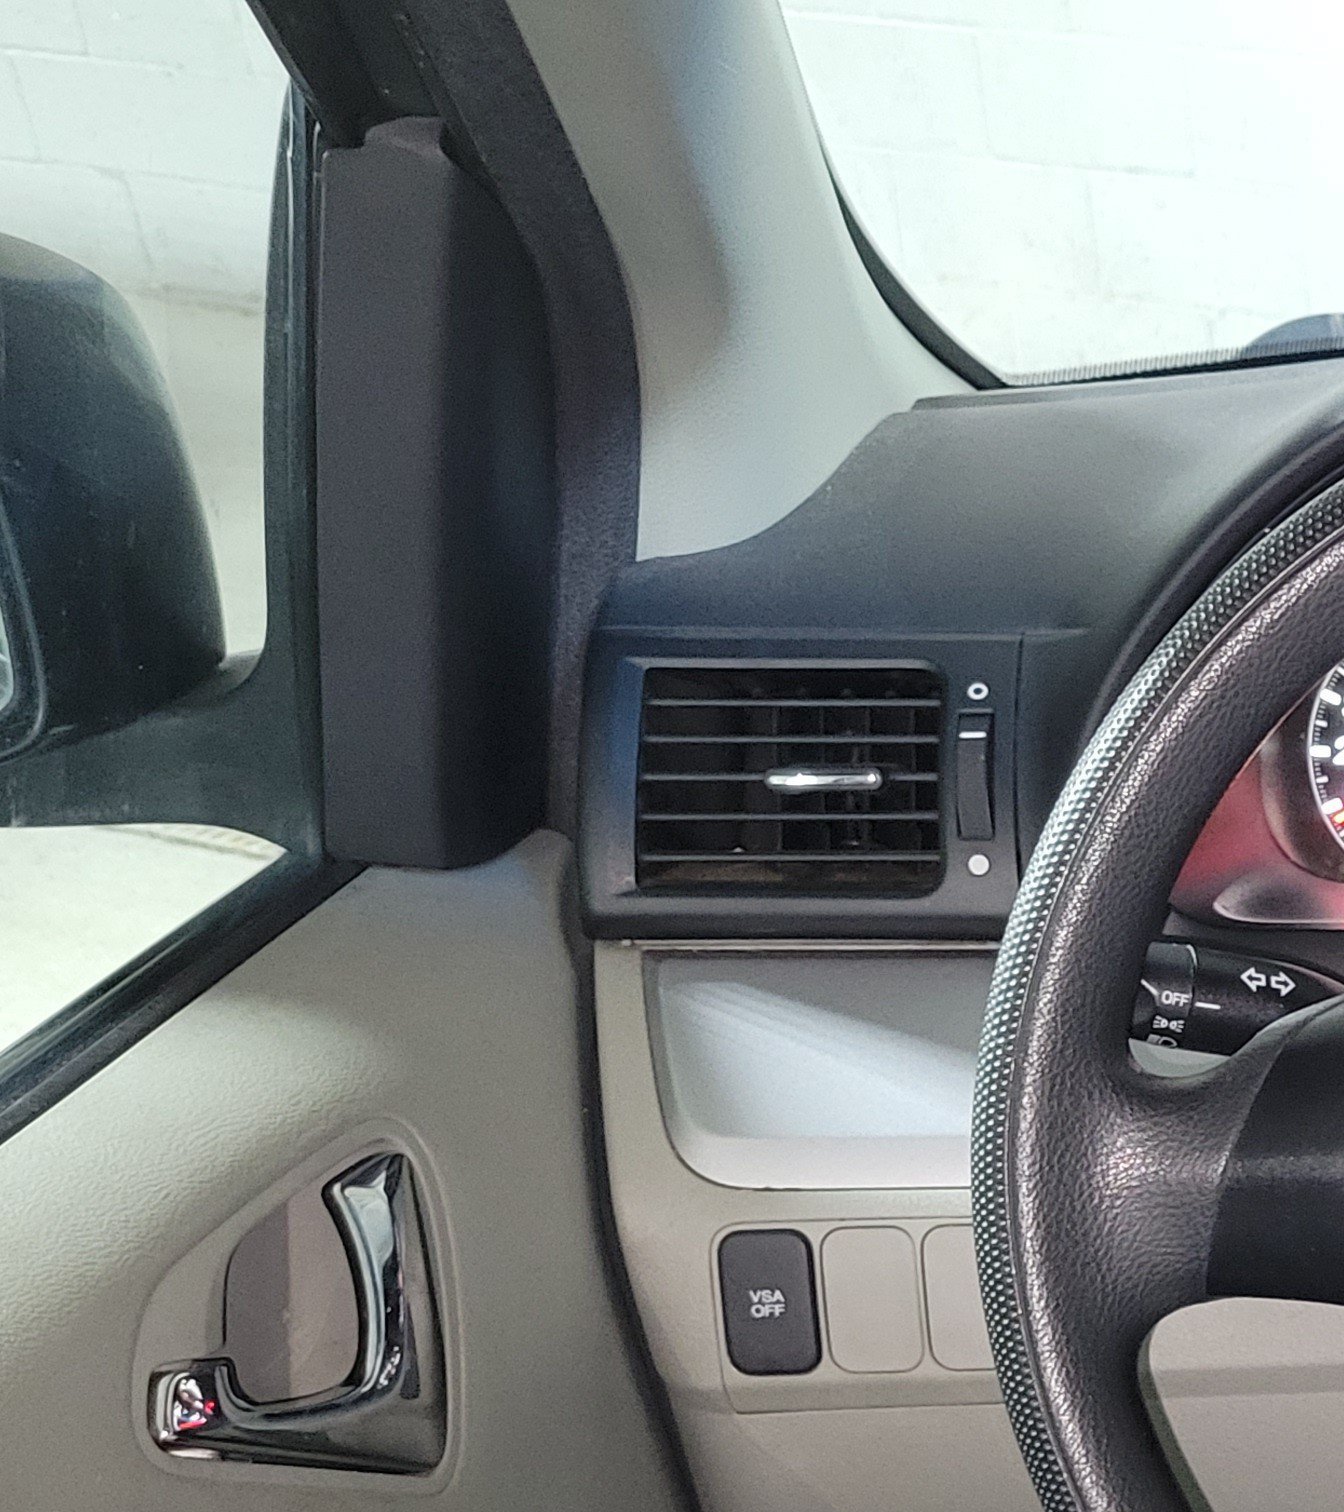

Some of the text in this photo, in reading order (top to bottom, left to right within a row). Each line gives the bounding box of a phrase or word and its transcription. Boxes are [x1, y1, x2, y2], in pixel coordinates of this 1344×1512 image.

[1161, 990, 1190, 1007] OFF
[749, 1289, 786, 1304] VSA
[750, 1303, 786, 1318] OFF
